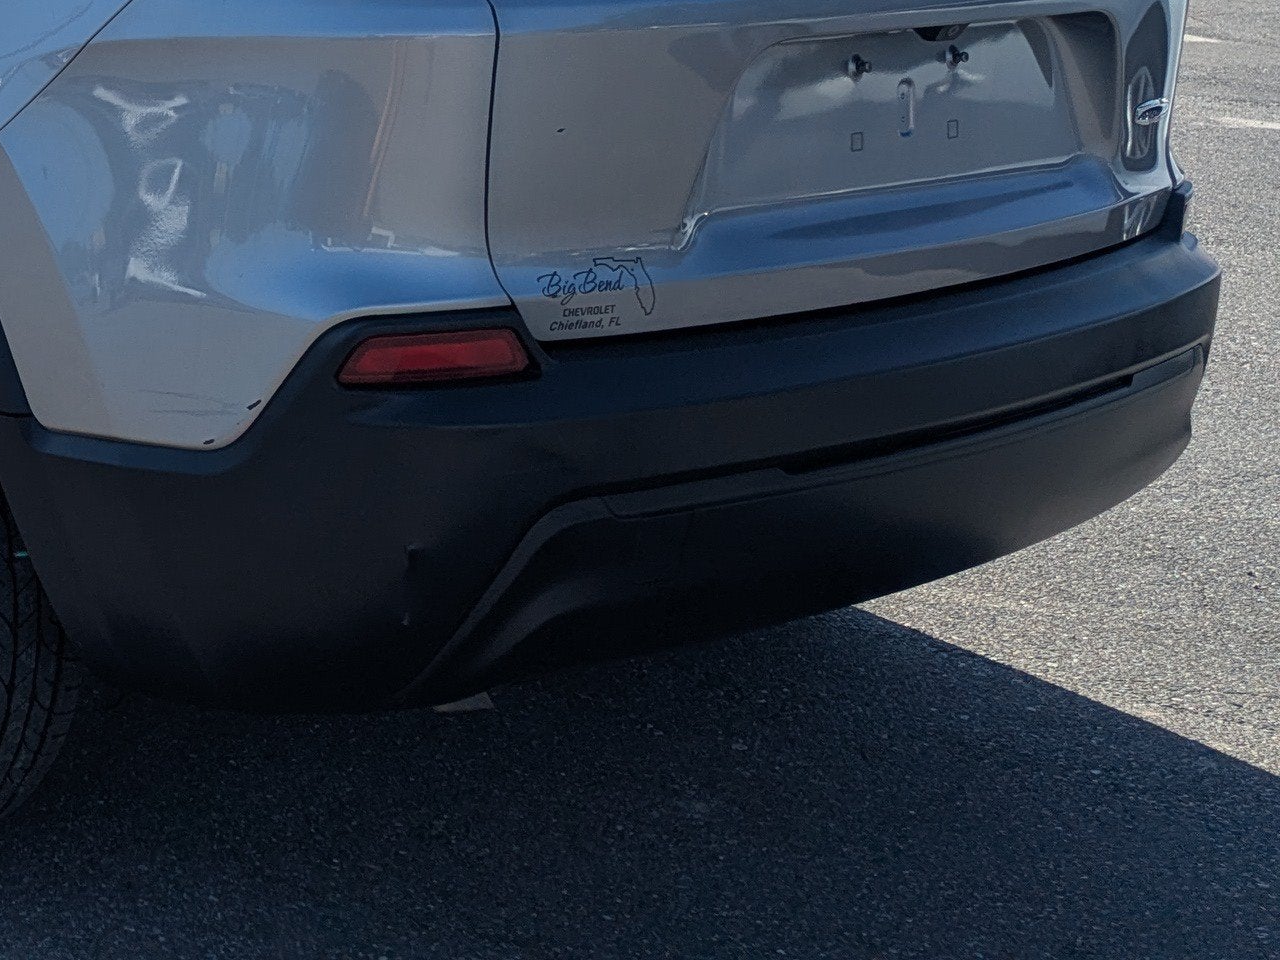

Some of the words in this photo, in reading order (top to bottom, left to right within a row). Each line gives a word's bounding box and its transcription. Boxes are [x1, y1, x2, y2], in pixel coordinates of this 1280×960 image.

[537, 271, 577, 305] Big
[573, 268, 625, 295] Bend
[562, 304, 617, 318] CHEVROLET
[549, 317, 604, 332] Chiefland,
[608, 316, 621, 327] FL
